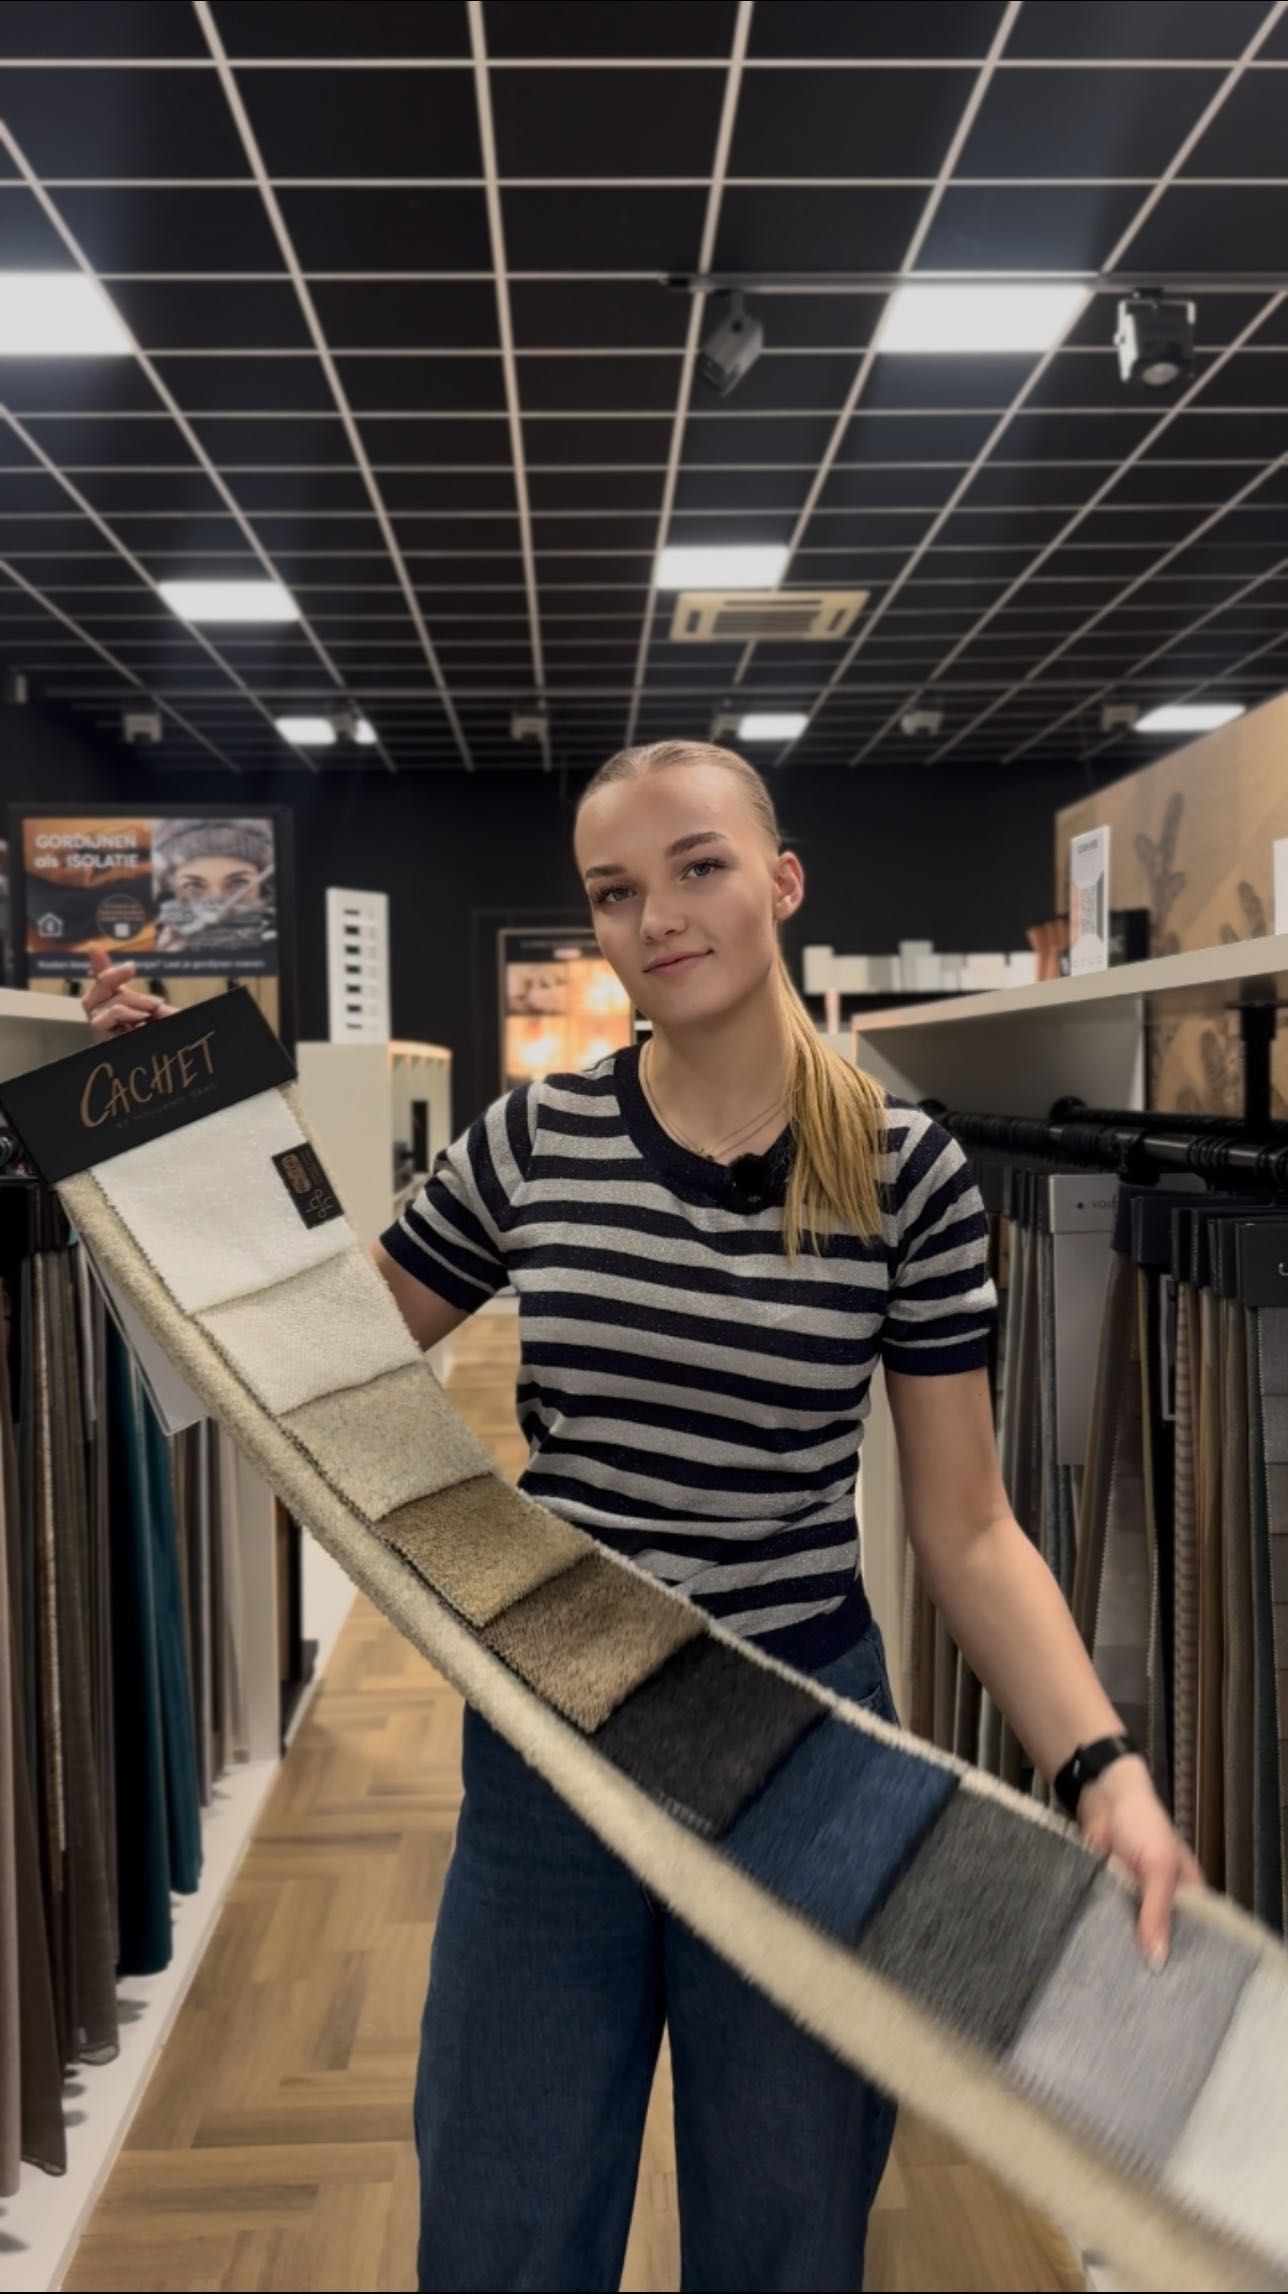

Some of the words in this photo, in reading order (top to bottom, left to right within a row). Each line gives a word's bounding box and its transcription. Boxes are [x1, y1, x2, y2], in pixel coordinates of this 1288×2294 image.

[35, 834, 137, 849] GORDIJNEN
[34, 854, 59, 869] als
[65, 853, 139, 869] ISOLATIE
[80, 1029, 216, 1128] CACHET
